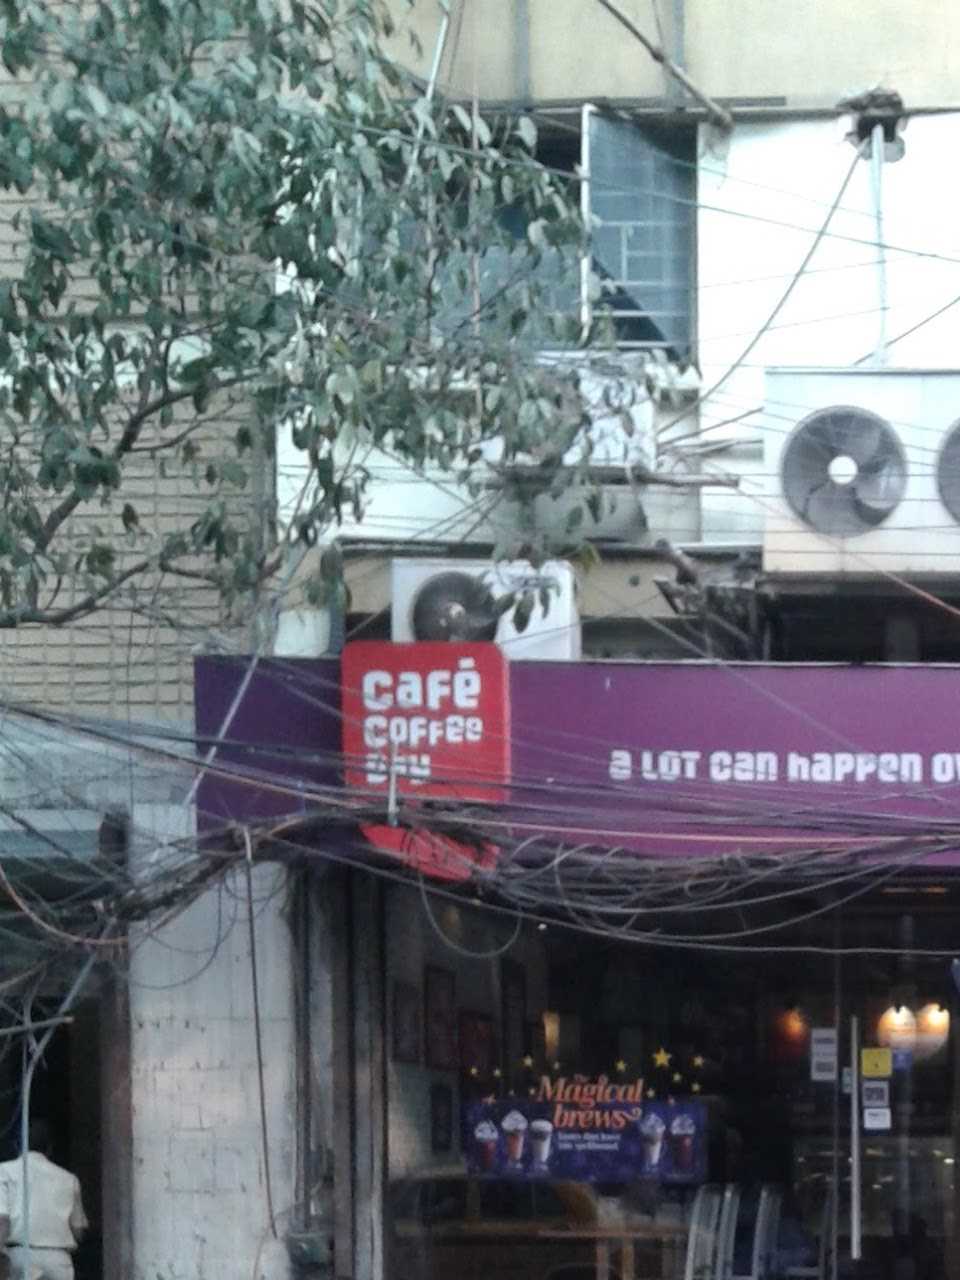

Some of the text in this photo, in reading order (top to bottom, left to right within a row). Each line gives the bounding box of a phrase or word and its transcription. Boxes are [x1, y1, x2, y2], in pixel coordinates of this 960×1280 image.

[363, 657, 481, 711] Café
[364, 715, 484, 748] Coffee
[609, 750, 632, 781] a
[709, 751, 778, 782] can
[787, 751, 923, 783] happen
[536, 1075, 645, 1107] Magical
[552, 1103, 643, 1130] brews
